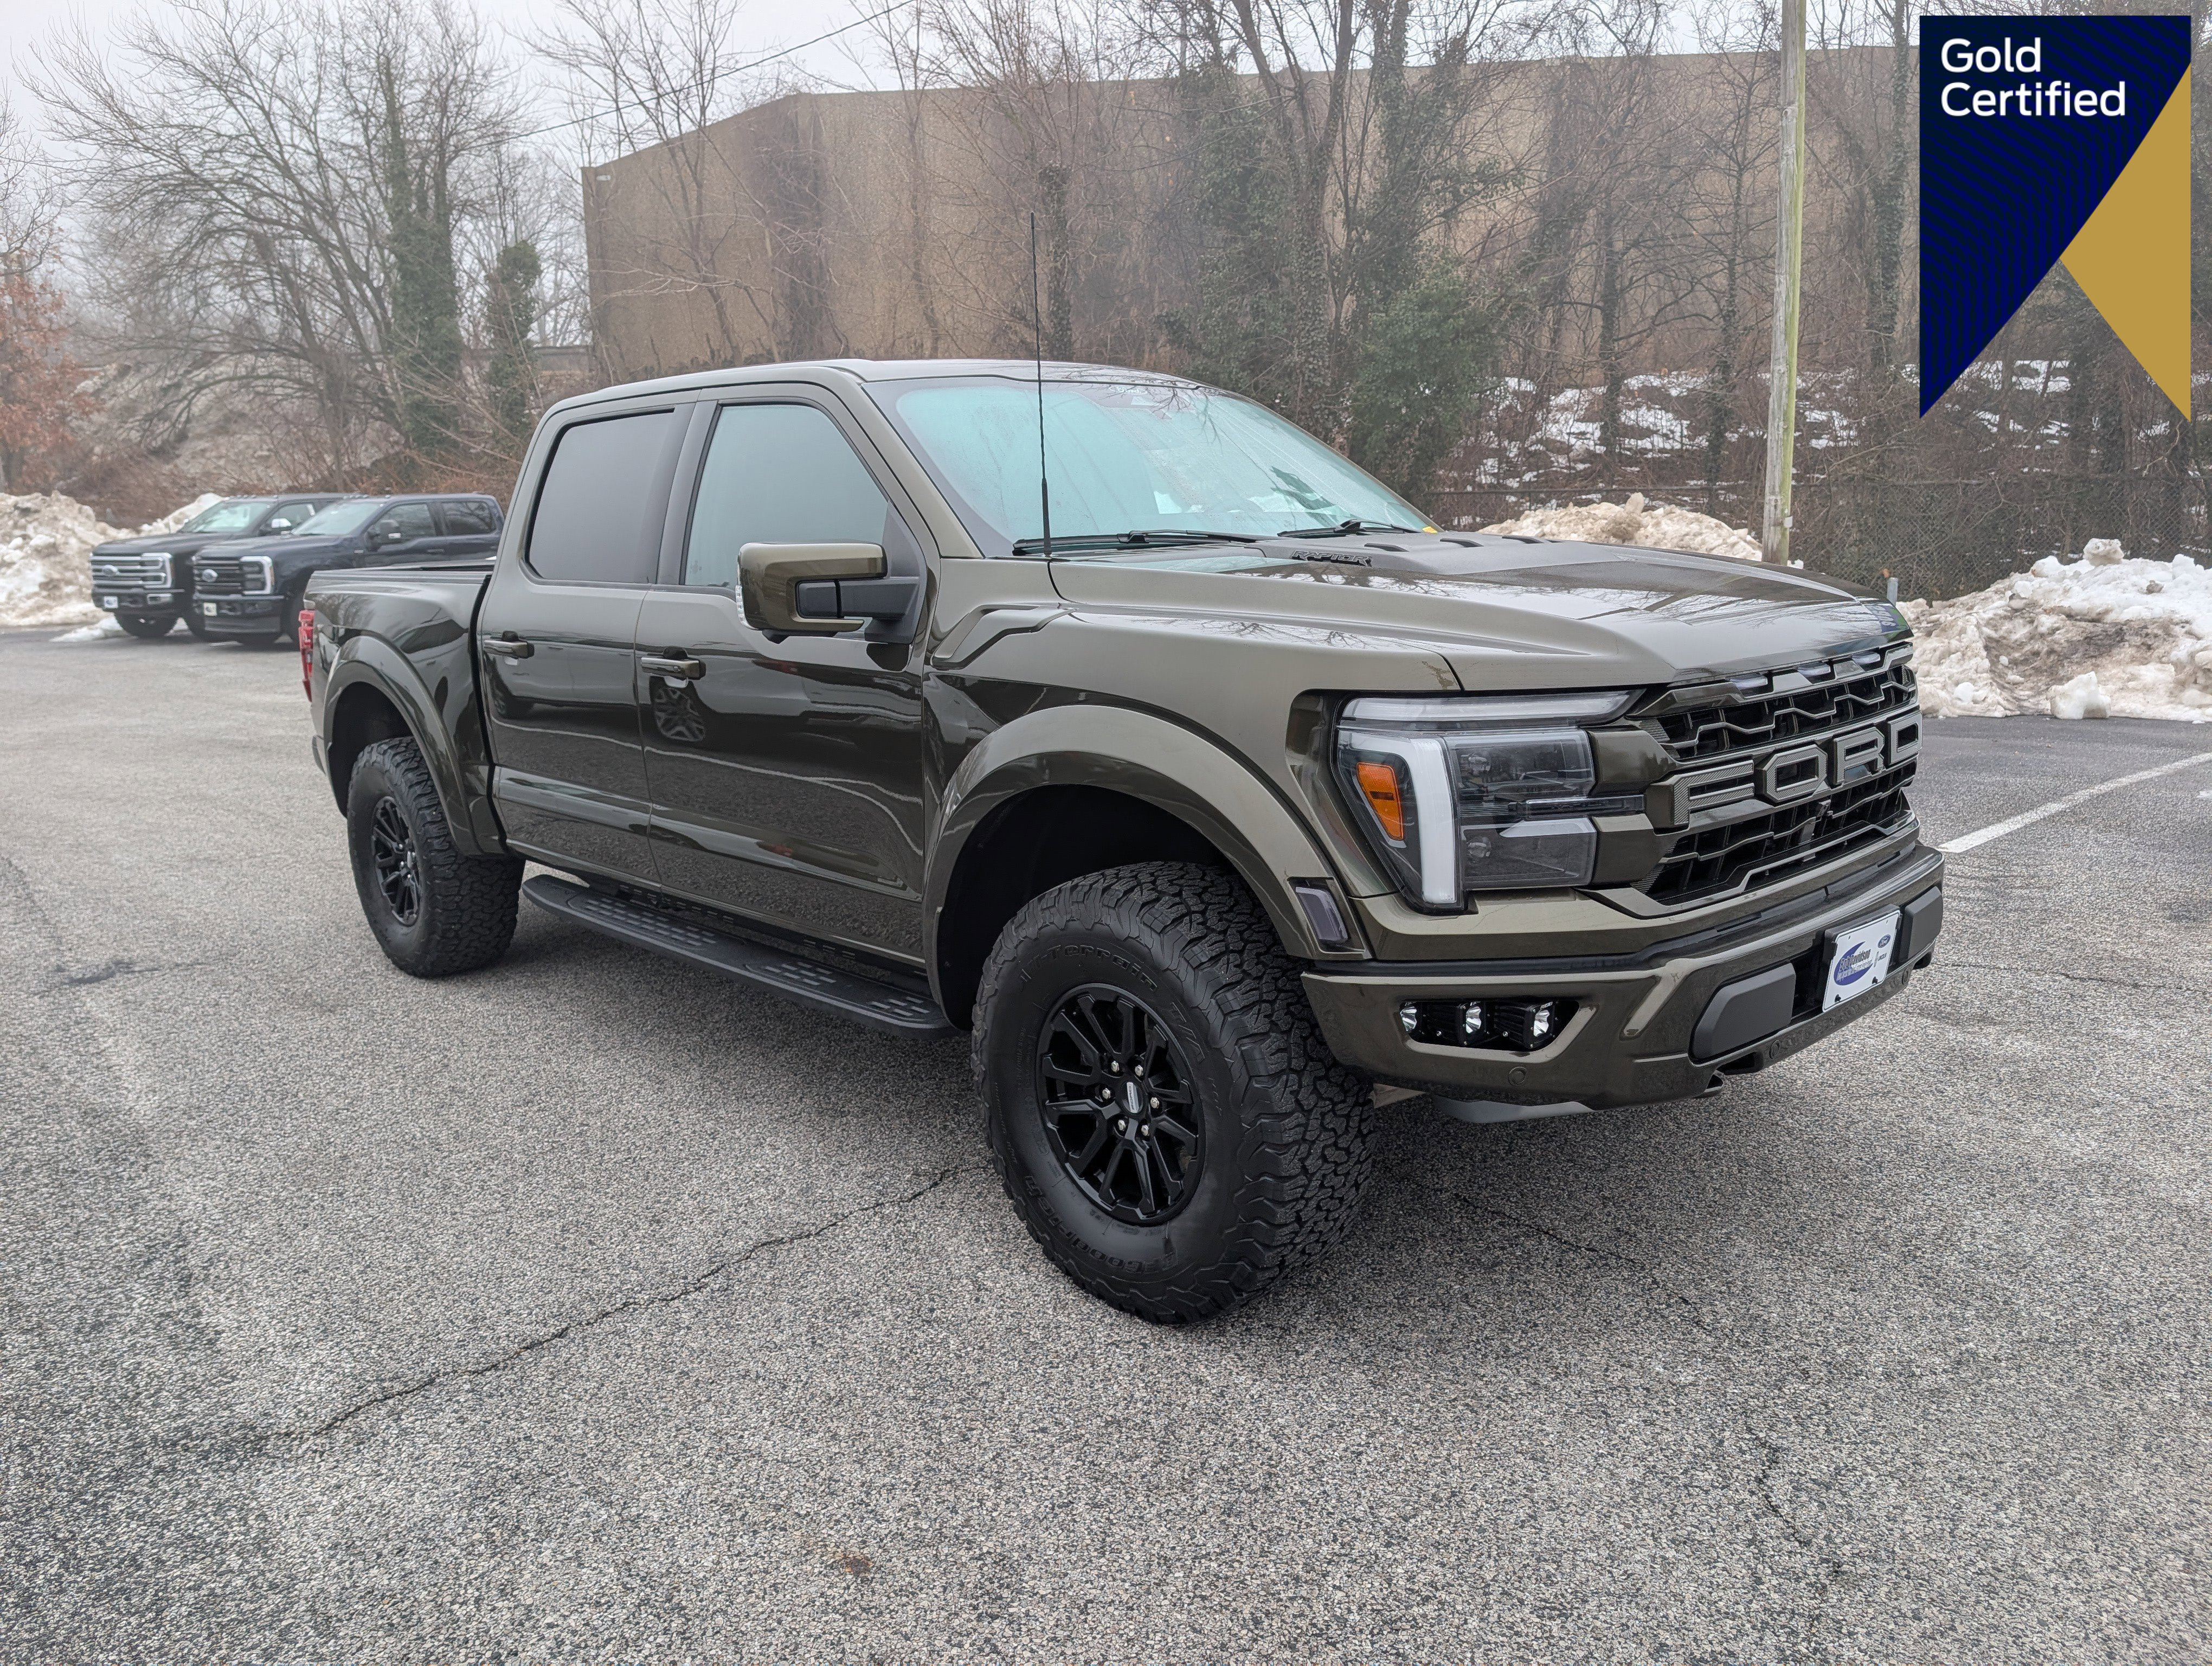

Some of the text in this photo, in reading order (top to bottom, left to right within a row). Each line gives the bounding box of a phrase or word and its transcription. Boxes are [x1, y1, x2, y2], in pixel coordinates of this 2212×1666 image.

[1292, 550, 1372, 567] RAPTOR
[1670, 711, 1923, 825] FORD
[1840, 955, 1850, 971] Bob
[1849, 949, 1871, 965] Davidson
